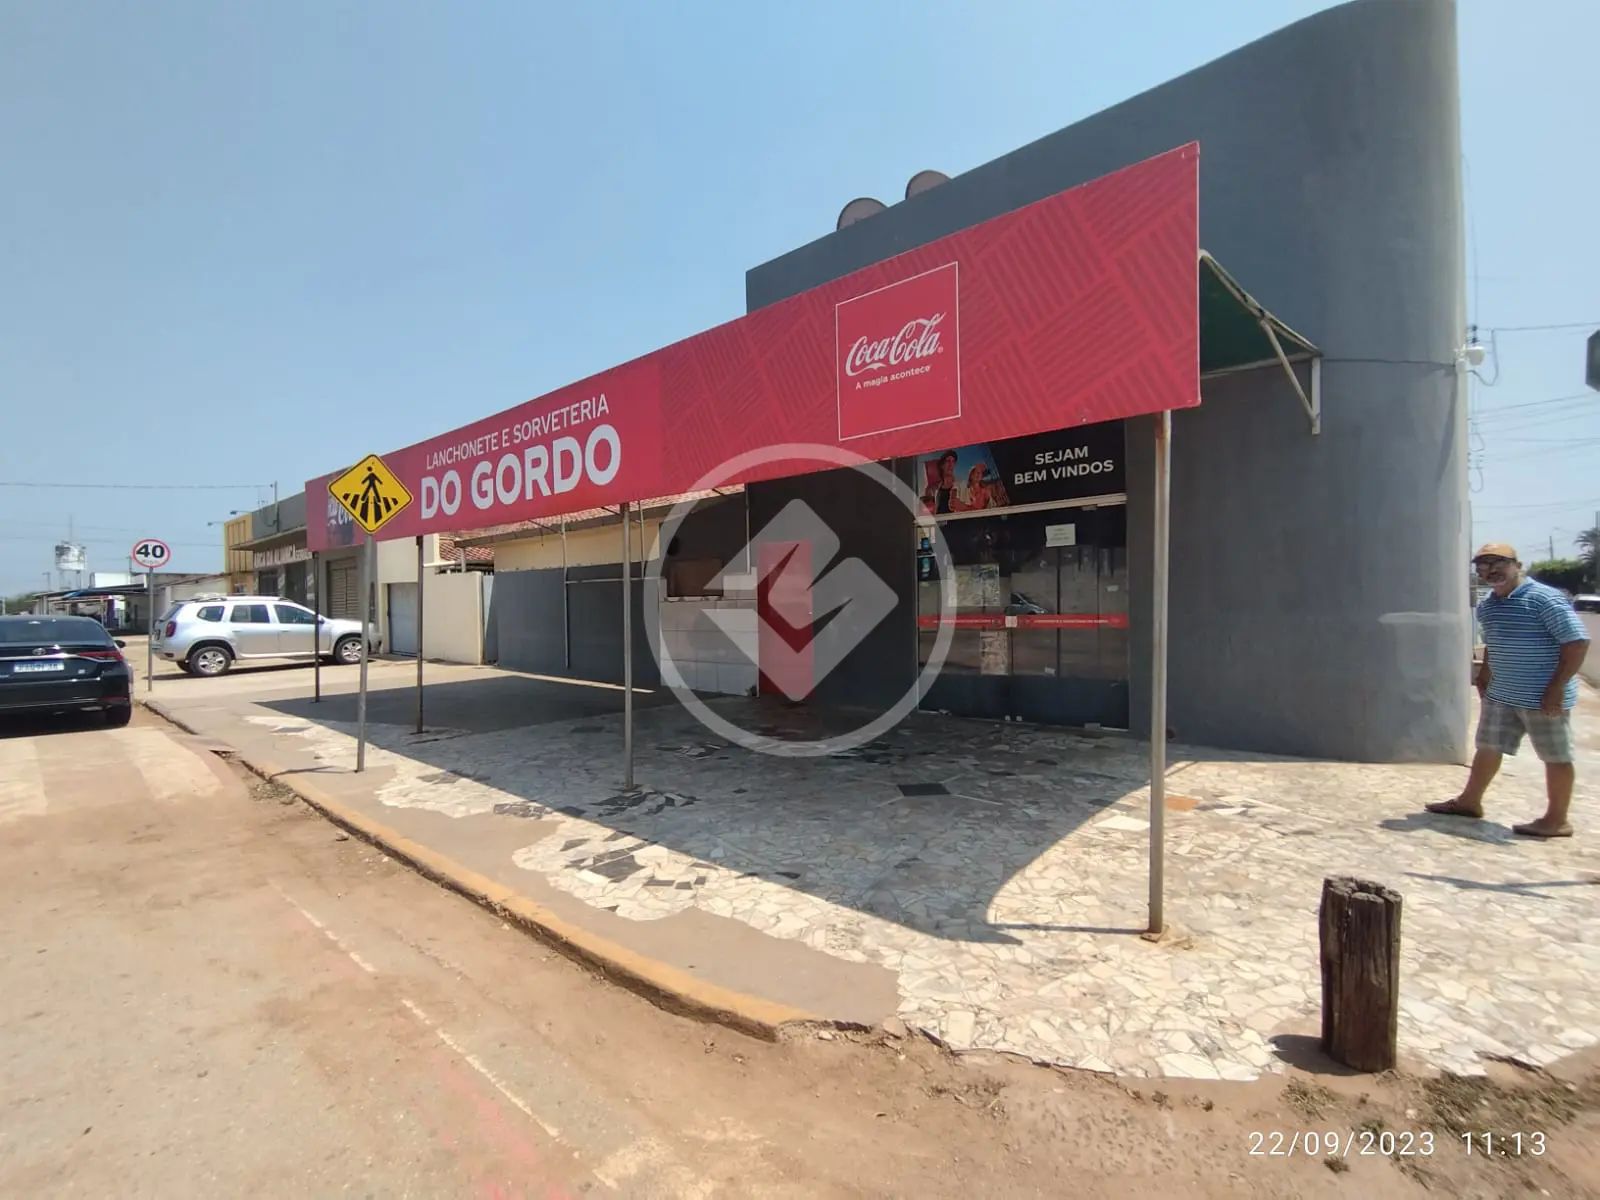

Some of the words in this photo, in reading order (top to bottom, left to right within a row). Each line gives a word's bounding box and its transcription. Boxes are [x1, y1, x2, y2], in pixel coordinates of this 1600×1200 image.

[846, 312, 946, 376] Coca-Cola
[855, 381, 862, 390] A
[863, 375, 888, 388] magia
[890, 365, 931, 381] acontece
[426, 432, 498, 470] LANCHONETE
[502, 428, 510, 447] E
[513, 394, 609, 442] SORVETERIA
[1035, 446, 1088, 465] SEJAM
[421, 470, 461, 519] DO
[471, 424, 621, 509] GORDO
[1014, 469, 1047, 485] BEM
[1051, 459, 1114, 480] VINDOS
[136, 544, 165, 558] 40
